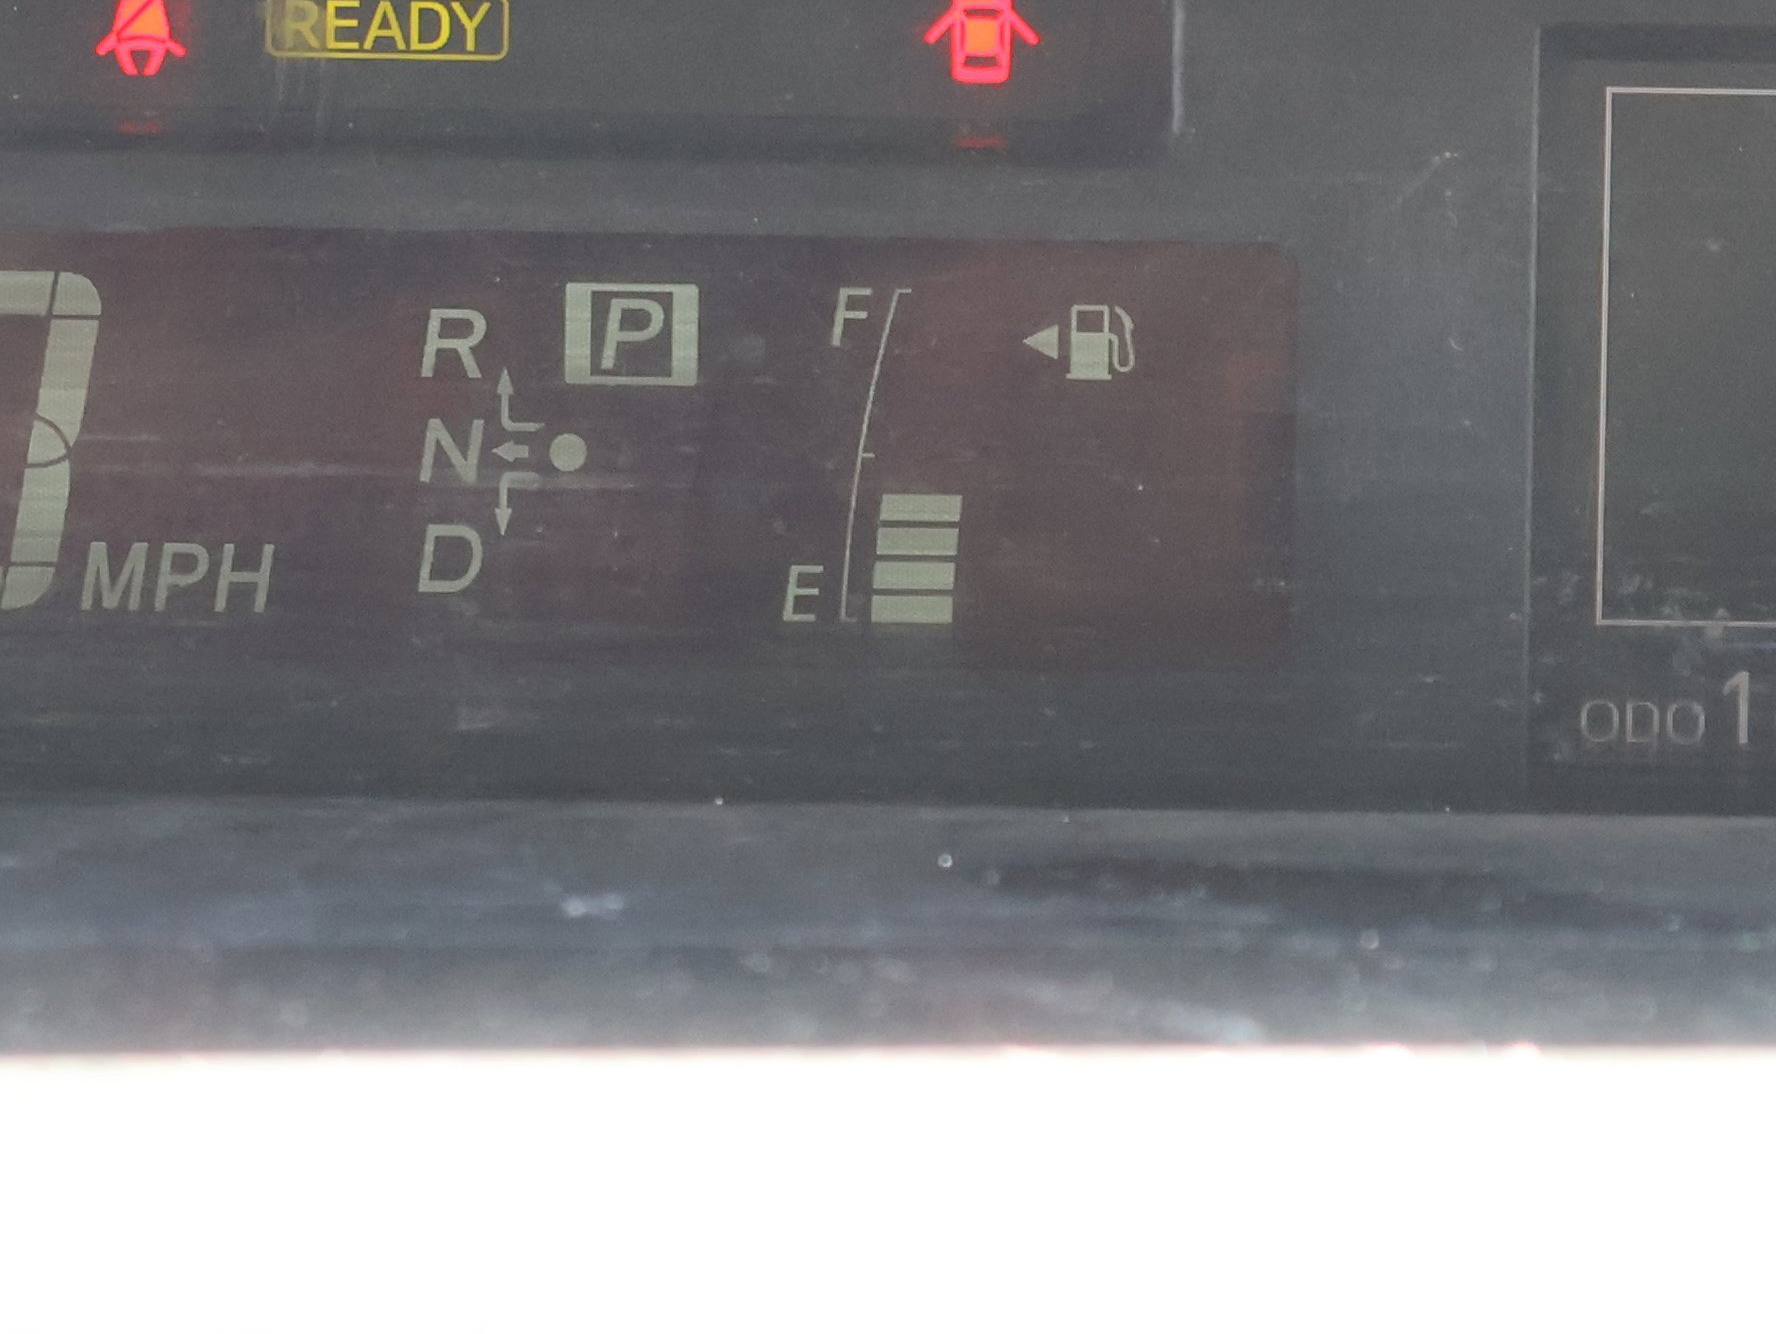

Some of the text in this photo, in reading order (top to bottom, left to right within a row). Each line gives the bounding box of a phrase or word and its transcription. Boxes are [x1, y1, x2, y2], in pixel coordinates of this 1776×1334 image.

[419, 307, 488, 380] R
[599, 297, 666, 370] P
[830, 286, 874, 348] F
[418, 416, 487, 487] N
[79, 539, 276, 614] MPH
[417, 522, 484, 594] D
[781, 563, 825, 623] E
[1578, 696, 1707, 749] ODO
